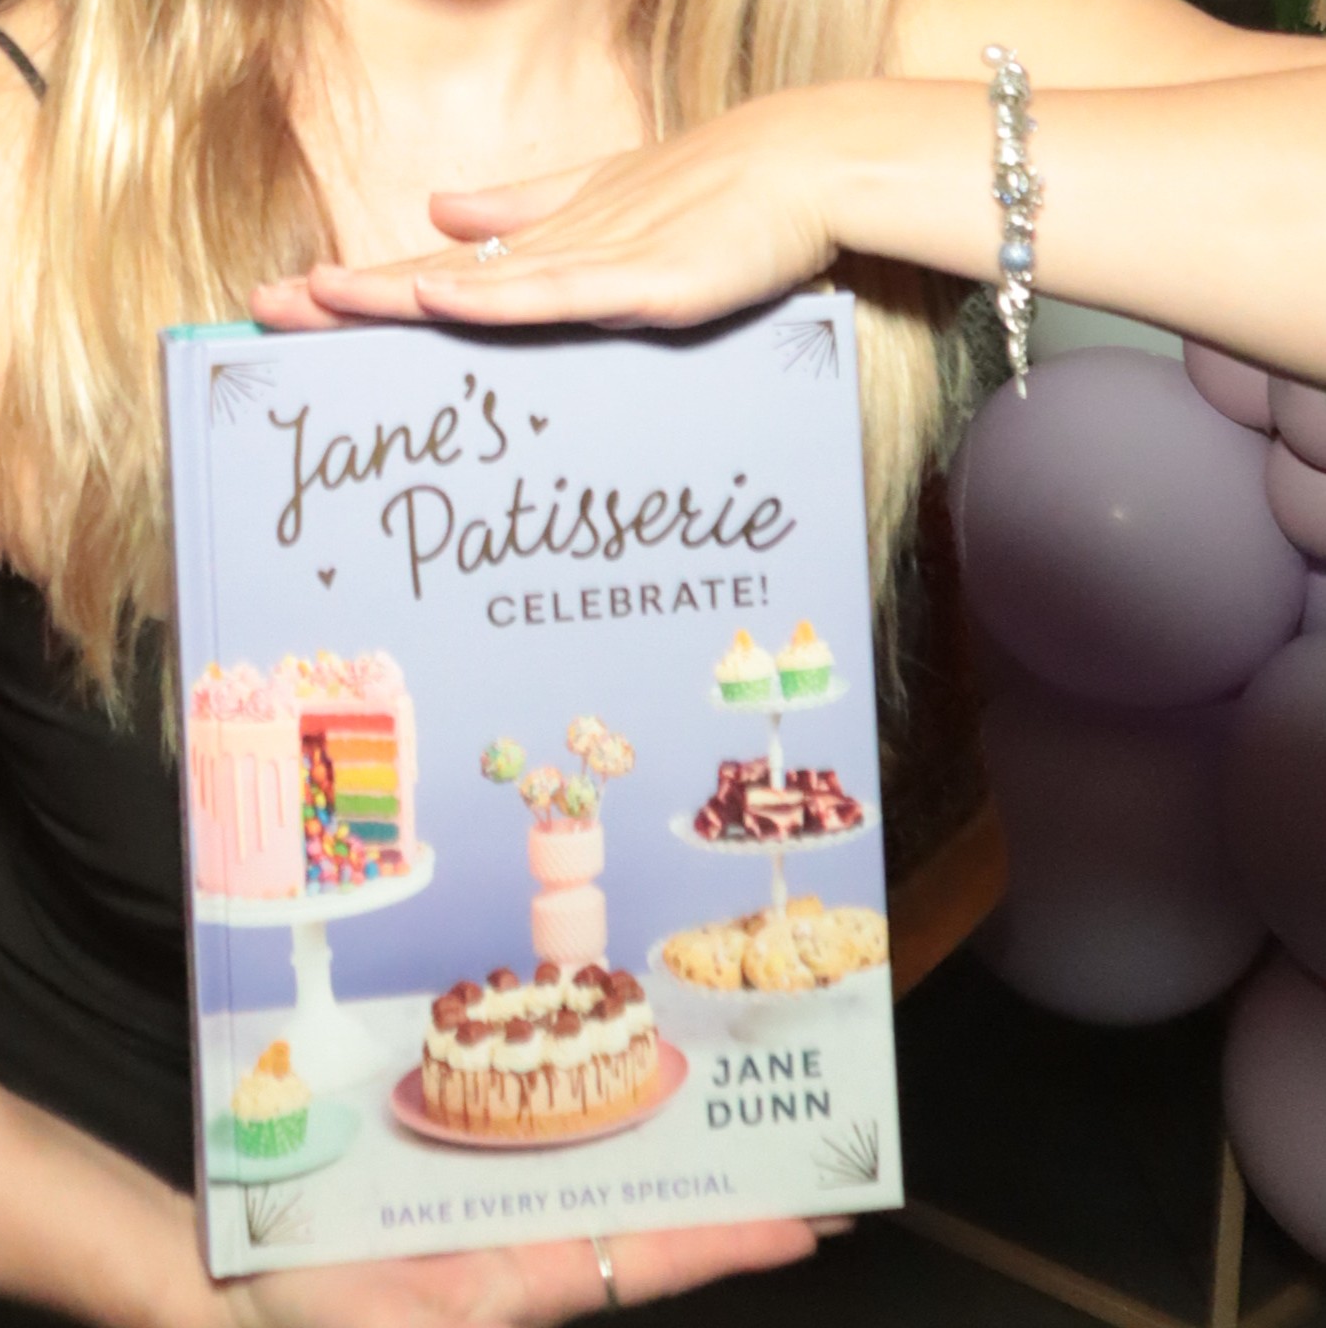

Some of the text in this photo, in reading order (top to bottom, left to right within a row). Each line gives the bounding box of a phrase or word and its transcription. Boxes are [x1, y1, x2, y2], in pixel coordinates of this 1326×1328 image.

[268, 373, 509, 547] Jane's
[381, 473, 797, 600] Patisserie
[486, 574, 770, 628] CELEBRATE!
[712, 1048, 822, 1087] JANE
[706, 1089, 831, 1130] DUNN
[380, 1174, 737, 1228] BAKE EVERY DAY SPECIAL
